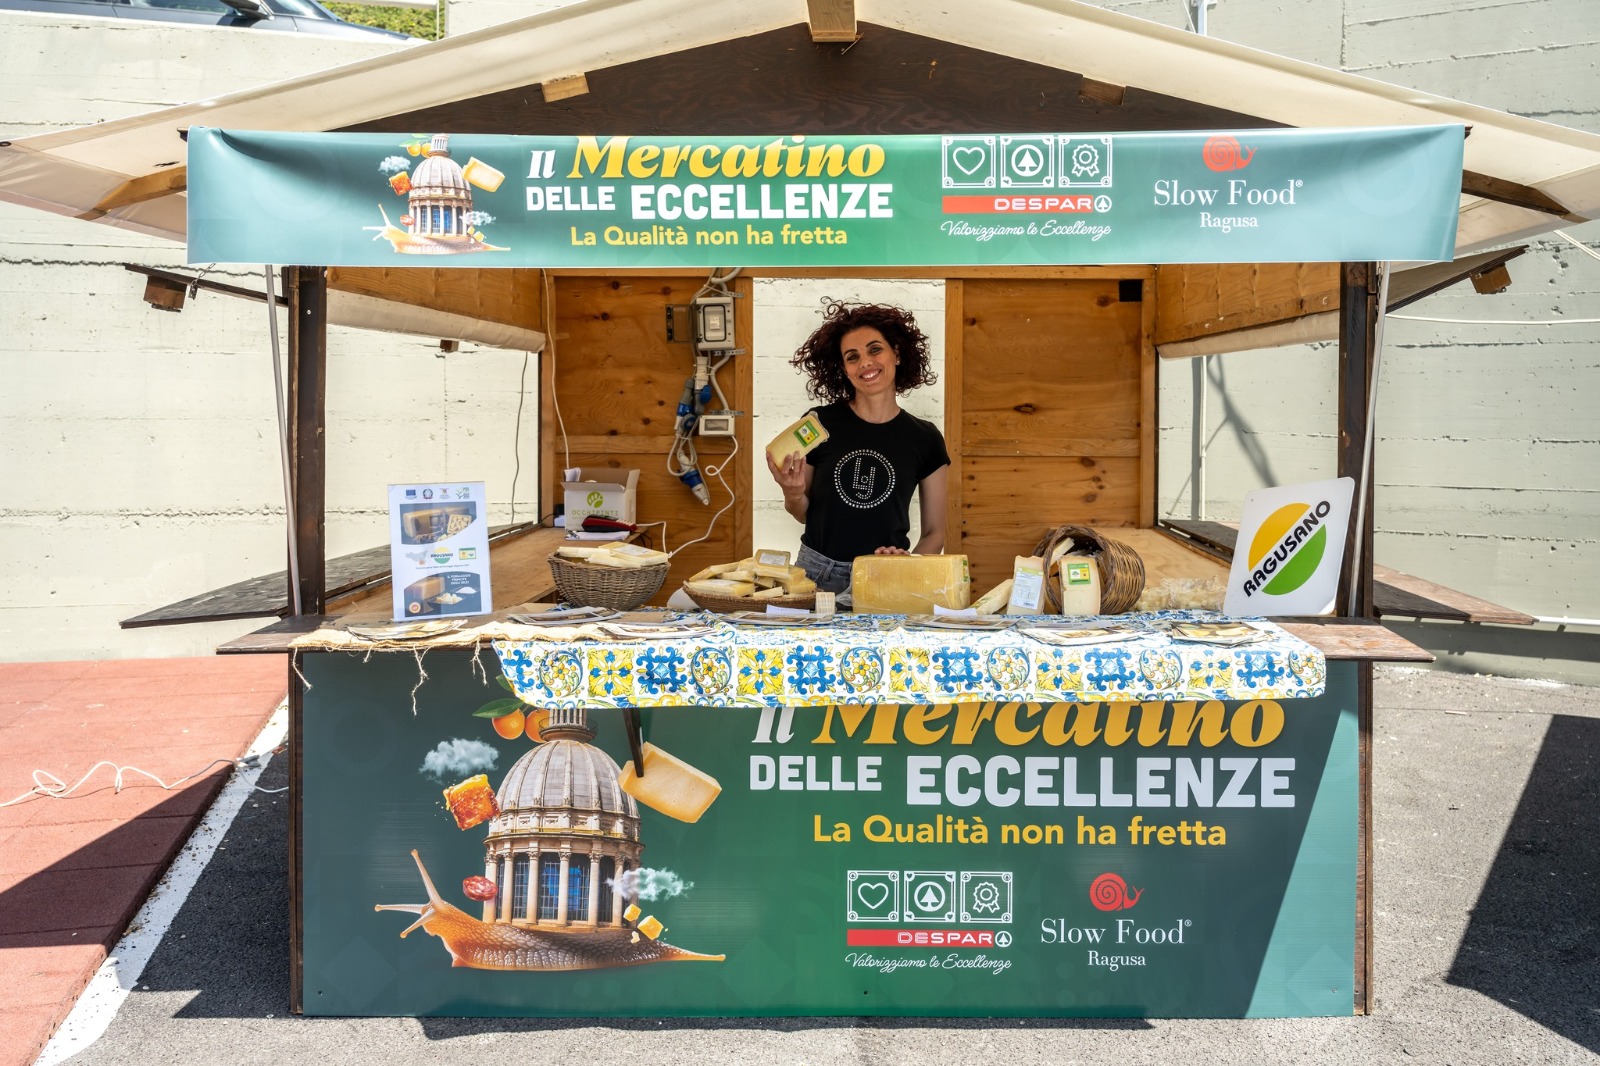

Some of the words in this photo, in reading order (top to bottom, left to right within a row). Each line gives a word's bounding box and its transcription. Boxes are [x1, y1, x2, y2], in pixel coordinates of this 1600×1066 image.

[526, 149, 556, 179] Il
[566, 136, 886, 179] Mercatino
[526, 185, 616, 211] DELLE
[631, 183, 894, 220] ECCELLENZE
[994, 197, 1092, 211] DESPAR
[1153, 179, 1219, 206] Slow
[570, 226, 597, 246] La
[603, 224, 689, 246] Qualità
[695, 230, 739, 246] non
[746, 224, 774, 245] ha
[780, 223, 848, 245] fretta
[940, 219, 1025, 241] Valorizziamo
[1026, 222, 1038, 235] le
[1039, 219, 1112, 241] Eccellenze
[1199, 212, 1259, 234] Ragusa
[1243, 500, 1331, 597] RAGUSANO
[811, 699, 1284, 747] Mercatino
[749, 755, 882, 791] DELLE
[906, 754, 1296, 808] ECCELLENZE
[813, 814, 851, 843] La
[863, 814, 989, 844] Qualità
[1001, 823, 1064, 845] non
[1077, 815, 1117, 845] ha
[1127, 815, 1226, 846] fretta
[897, 931, 993, 945] DESPAR
[1040, 917, 1107, 944] Slow
[844, 952, 928, 973] Valorizziamo
[929, 954, 941, 969] le
[941, 953, 1012, 975] Eccellenze
[1087, 950, 1147, 972] Ragusa
